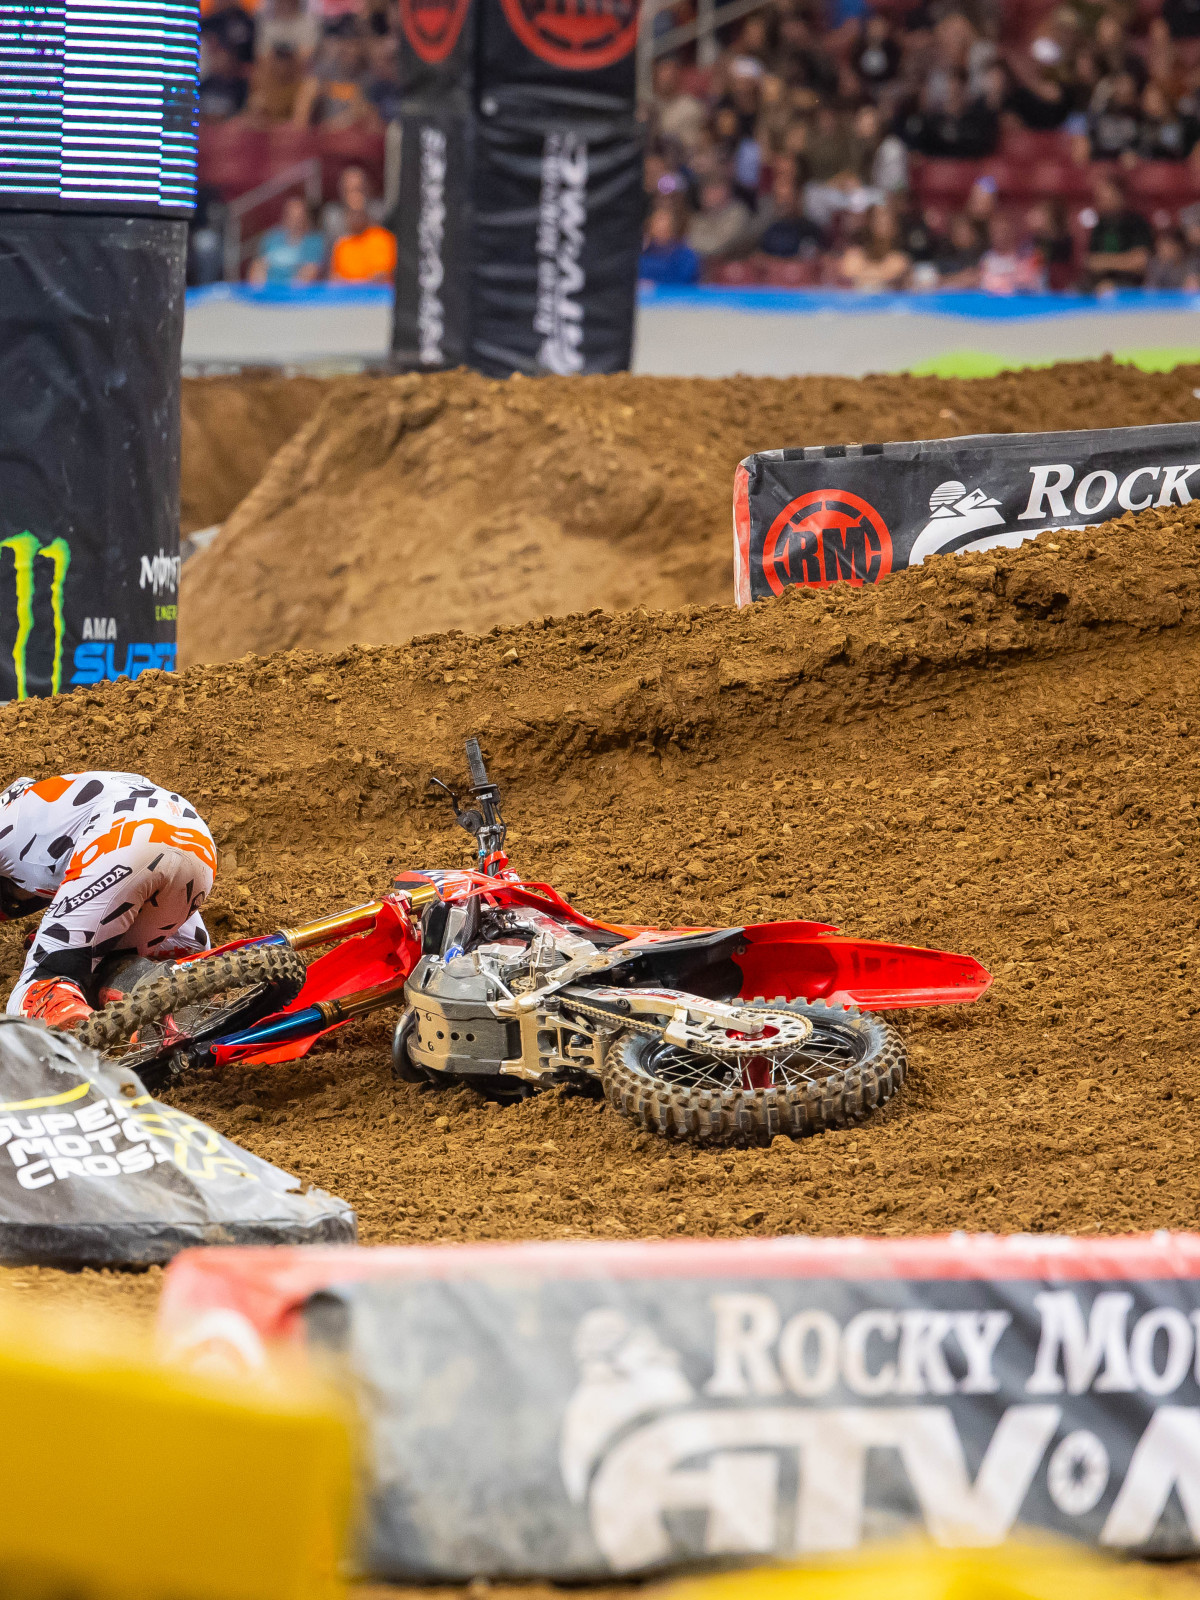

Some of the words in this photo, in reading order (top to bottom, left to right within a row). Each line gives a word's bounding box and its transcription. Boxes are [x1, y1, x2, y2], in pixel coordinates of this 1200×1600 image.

[1017, 463, 1200, 516] ROCK
[82, 617, 118, 641] AMA
[68, 866, 131, 910] HONDA
[705, 1292, 1010, 1397] ROCKY
[1025, 1289, 1200, 1397] MO
